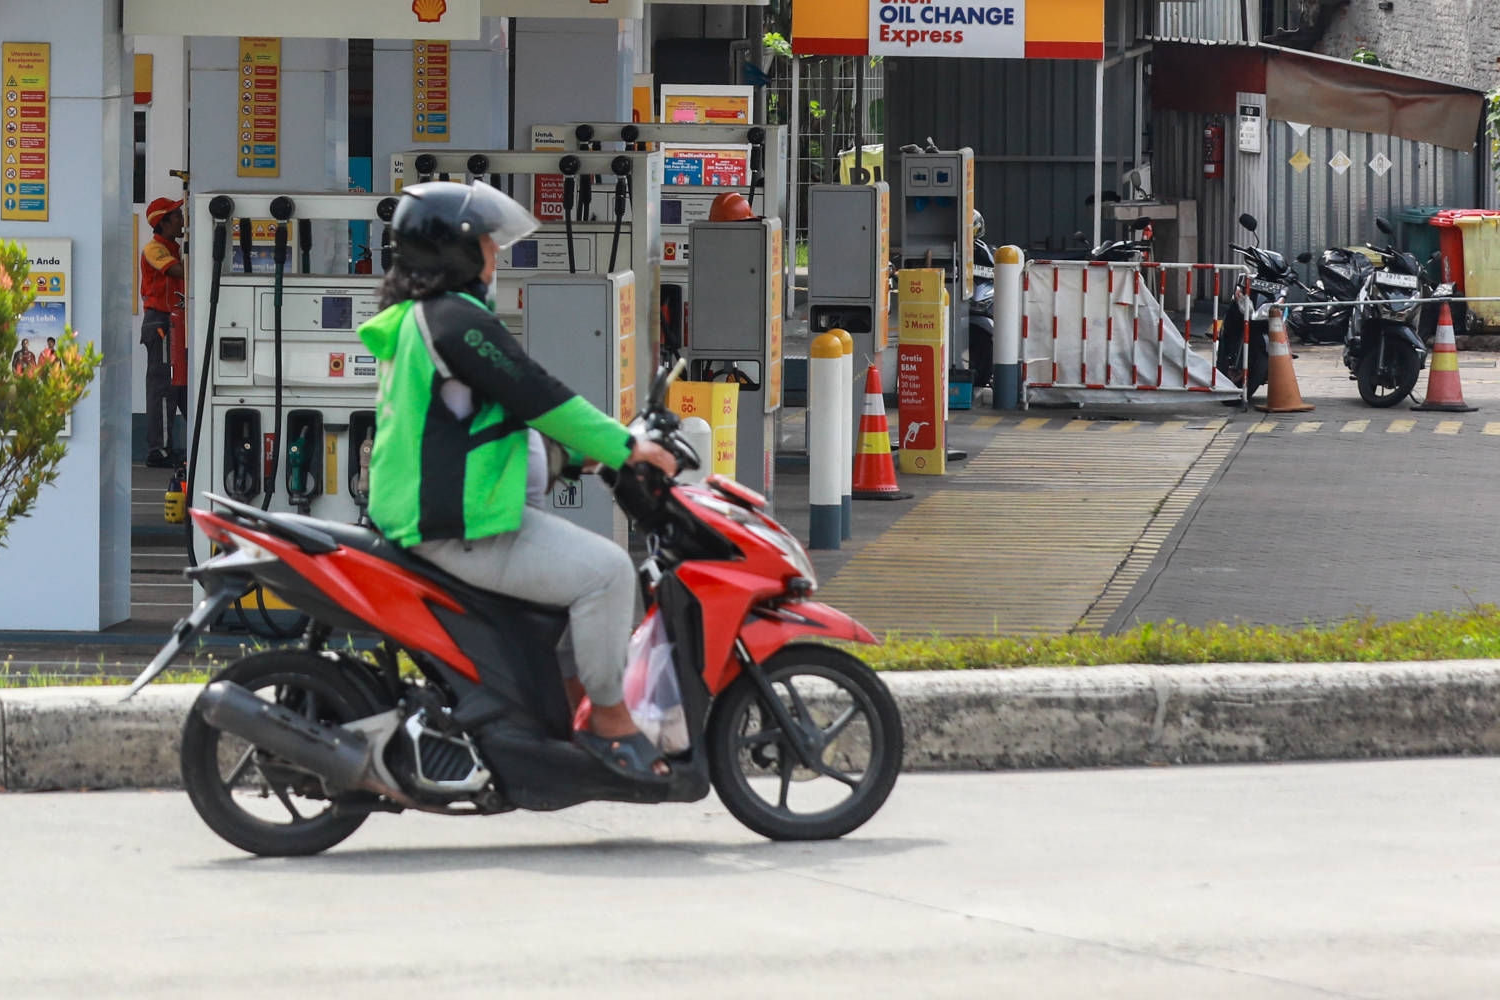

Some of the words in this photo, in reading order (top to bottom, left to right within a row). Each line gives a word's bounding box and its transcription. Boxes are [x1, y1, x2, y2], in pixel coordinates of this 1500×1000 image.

[880, 5, 916, 23] OIL
[920, 6, 1014, 26] CHANGE
[880, 24, 964, 47] Express
[543, 204, 562, 214] 100
[37, 257, 60, 265] Anda
[901, 354, 922, 362] Gratis
